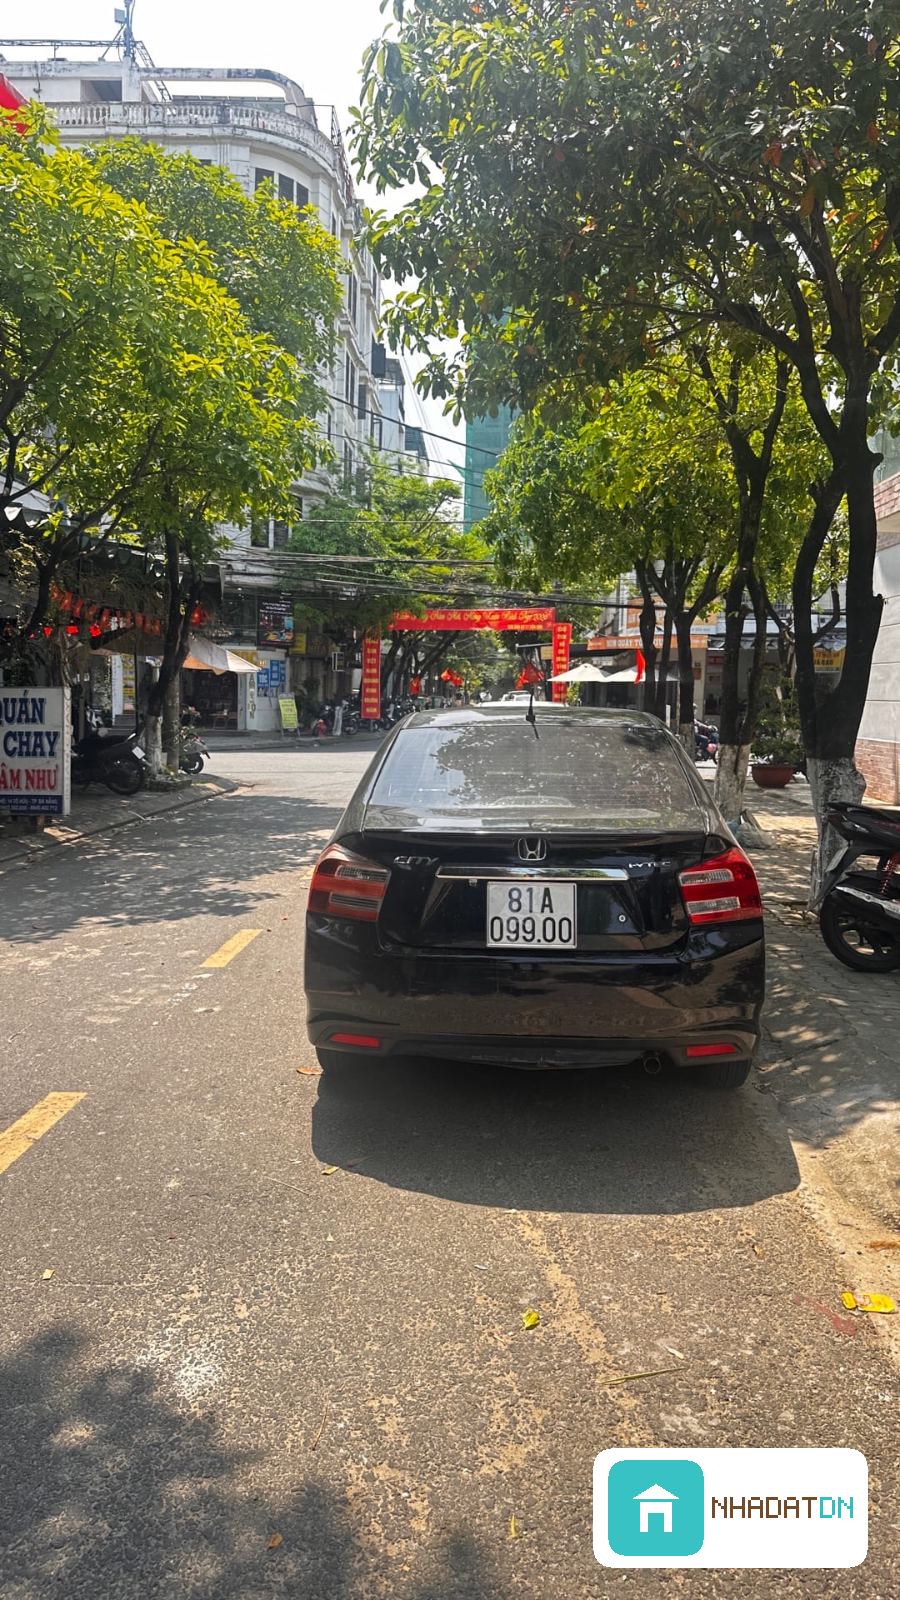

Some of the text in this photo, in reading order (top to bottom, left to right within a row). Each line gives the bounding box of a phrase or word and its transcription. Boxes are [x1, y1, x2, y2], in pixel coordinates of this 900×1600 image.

[0, 690, 45, 726] UÁN
[3, 731, 60, 757] CHAY
[25, 765, 58, 790] NHƯ
[394, 855, 440, 865] CITY
[508, 887, 554, 914] 81A
[490, 916, 572, 943] 099.00
